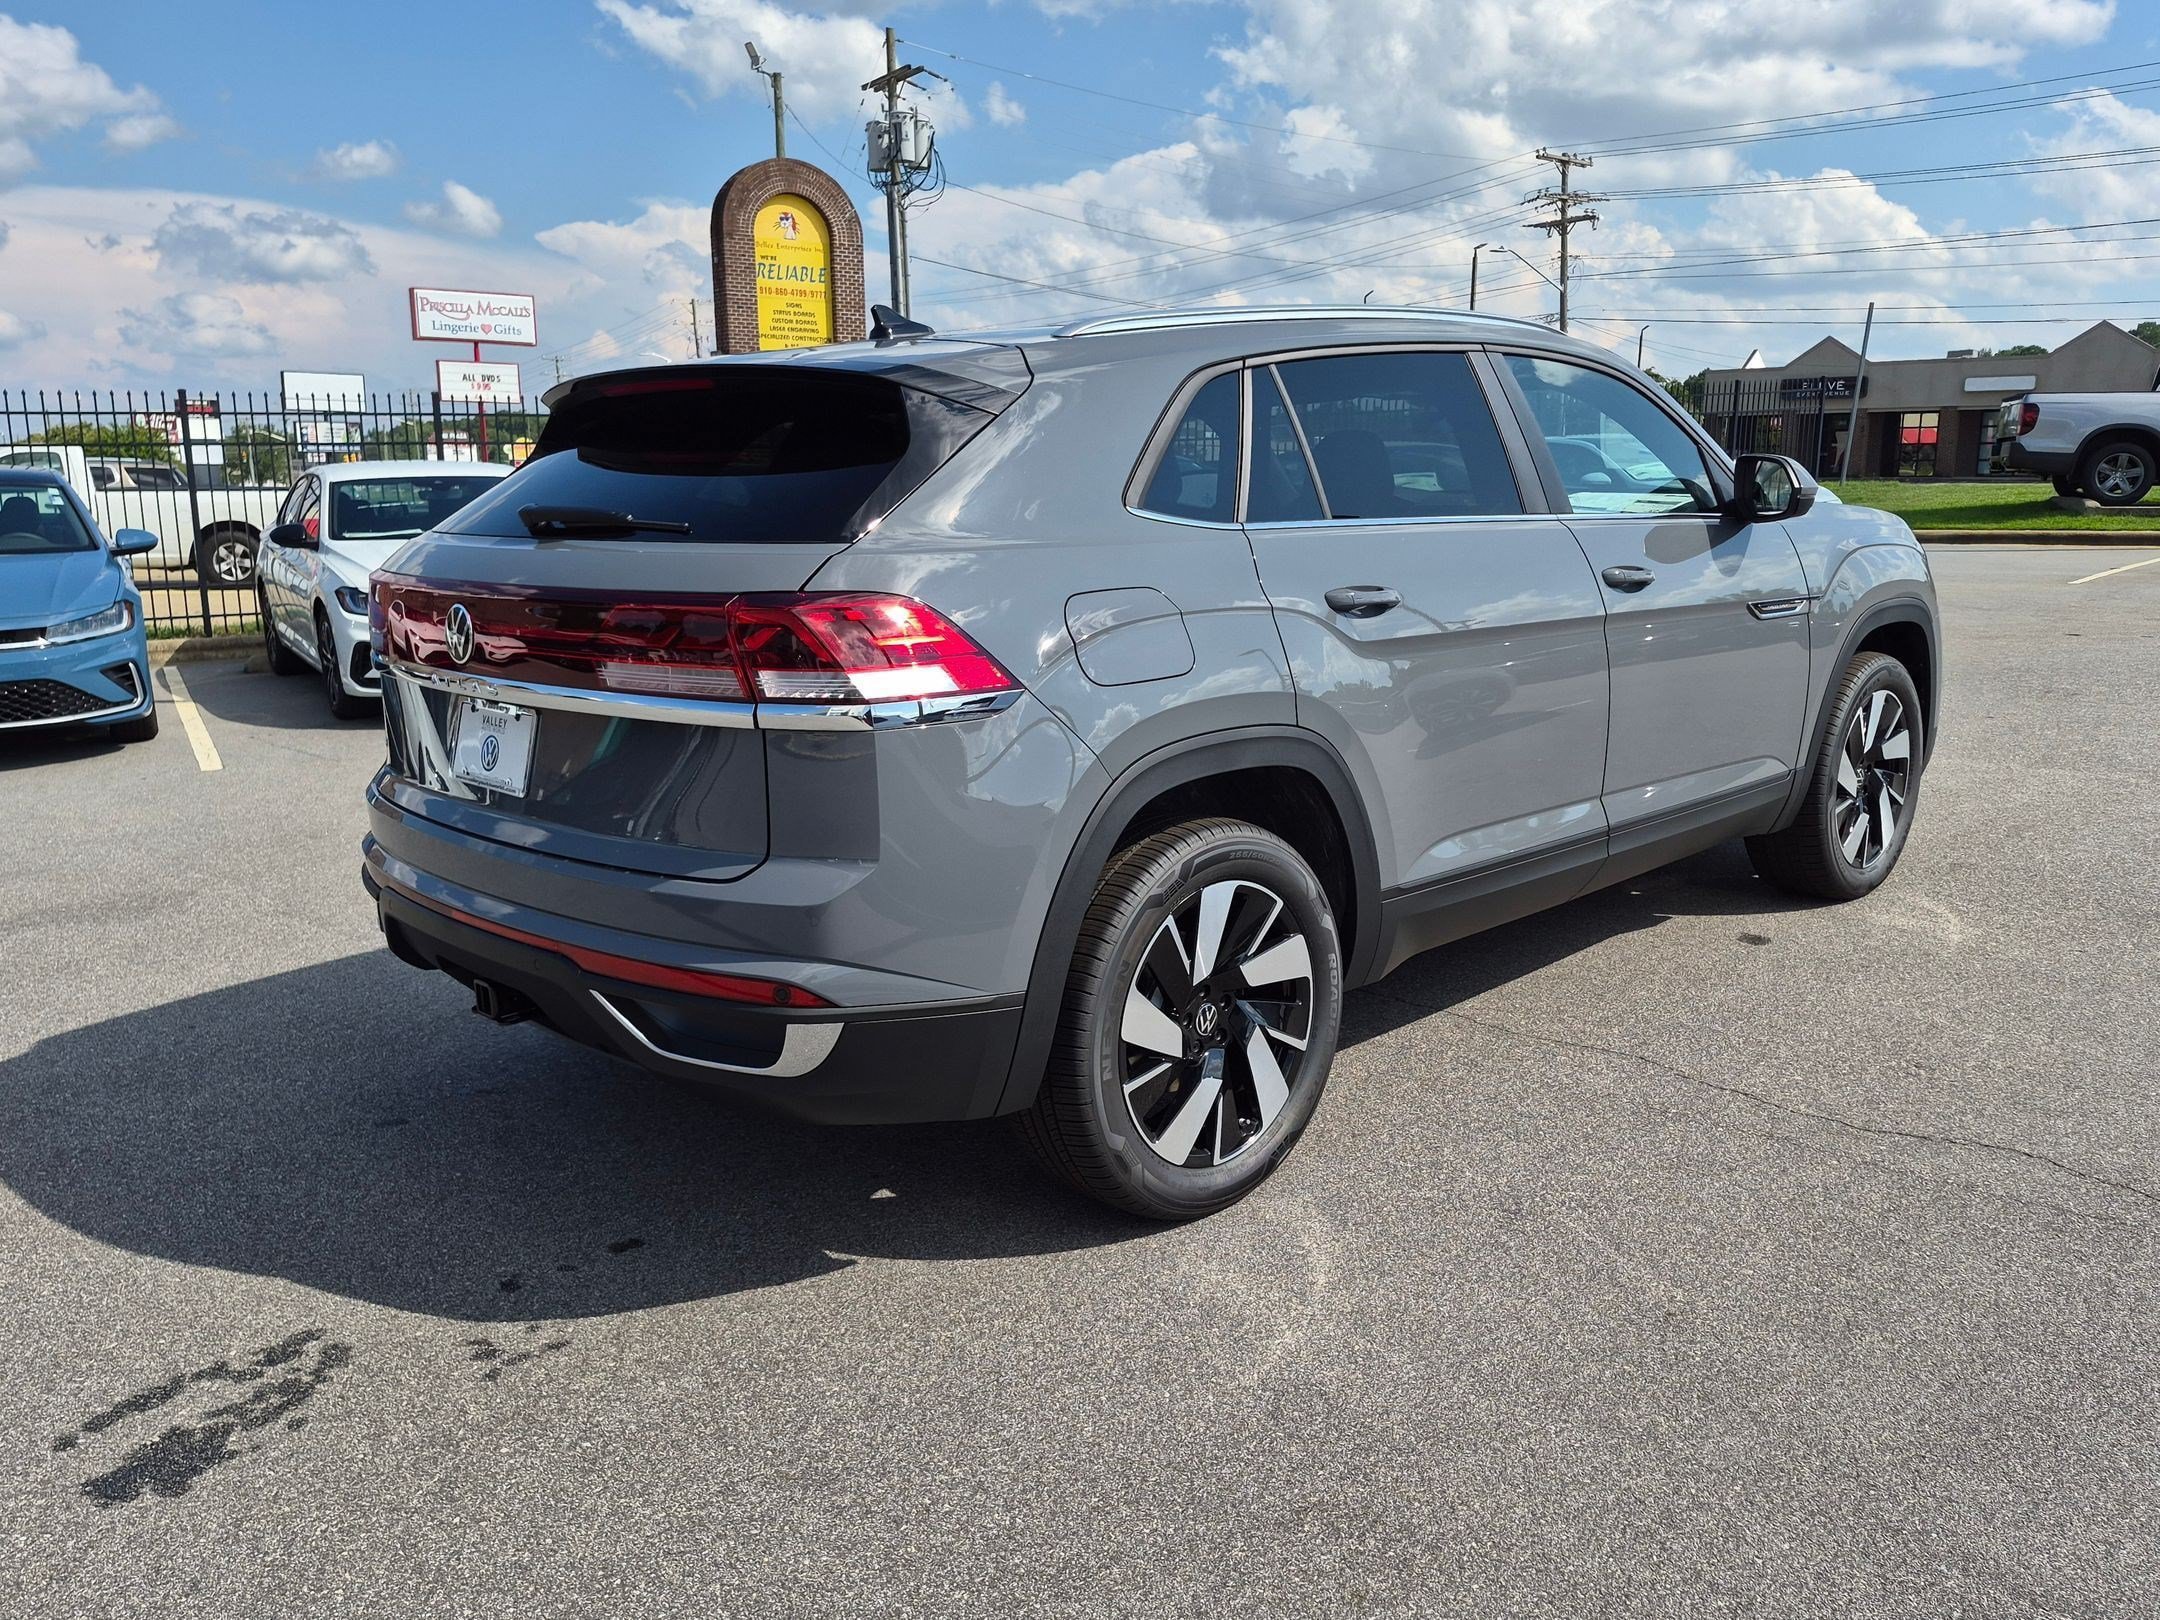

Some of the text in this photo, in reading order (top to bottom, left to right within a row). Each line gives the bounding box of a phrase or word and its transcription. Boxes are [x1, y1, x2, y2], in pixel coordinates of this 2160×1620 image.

[756, 262, 828, 283] RELIABLE
[771, 317, 794, 325] CUSTOM
[432, 320, 522, 336] Lingerie Gifts
[787, 326, 820, 334] ENGRAVING
[761, 333, 791, 341] PECIALIZED
[462, 373, 476, 382] ALL
[431, 673, 499, 697] ATLAS
[482, 714, 508, 729] VALLEY
